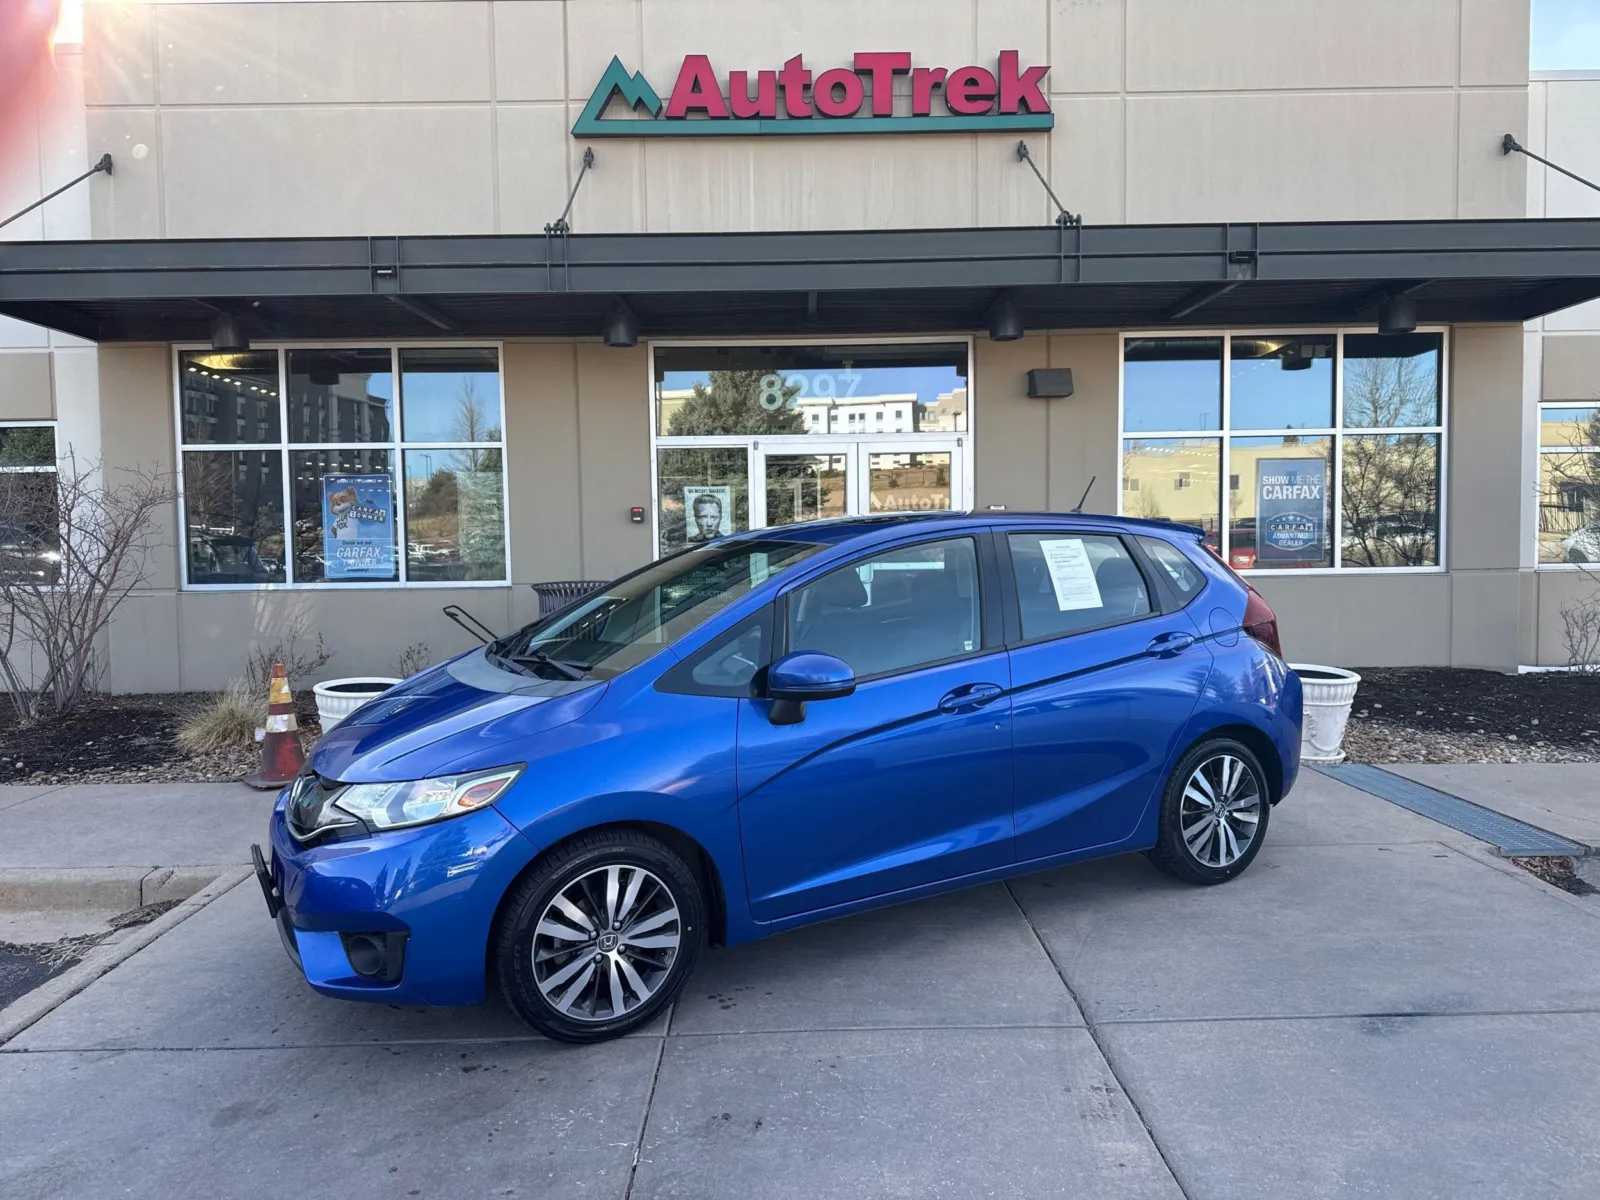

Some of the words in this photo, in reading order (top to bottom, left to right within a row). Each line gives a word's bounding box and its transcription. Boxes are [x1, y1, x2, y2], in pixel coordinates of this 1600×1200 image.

[664, 50, 1052, 119] AutoTrek
[759, 373, 862, 411] 8297
[1262, 475, 1290, 485] SHOW
[1291, 475, 1304, 485] ME
[1305, 474, 1321, 485] THE
[1262, 485, 1321, 500] CARFAX
[1270, 523, 1313, 532] CARFAX
[336, 546, 382, 558] CARFAX
